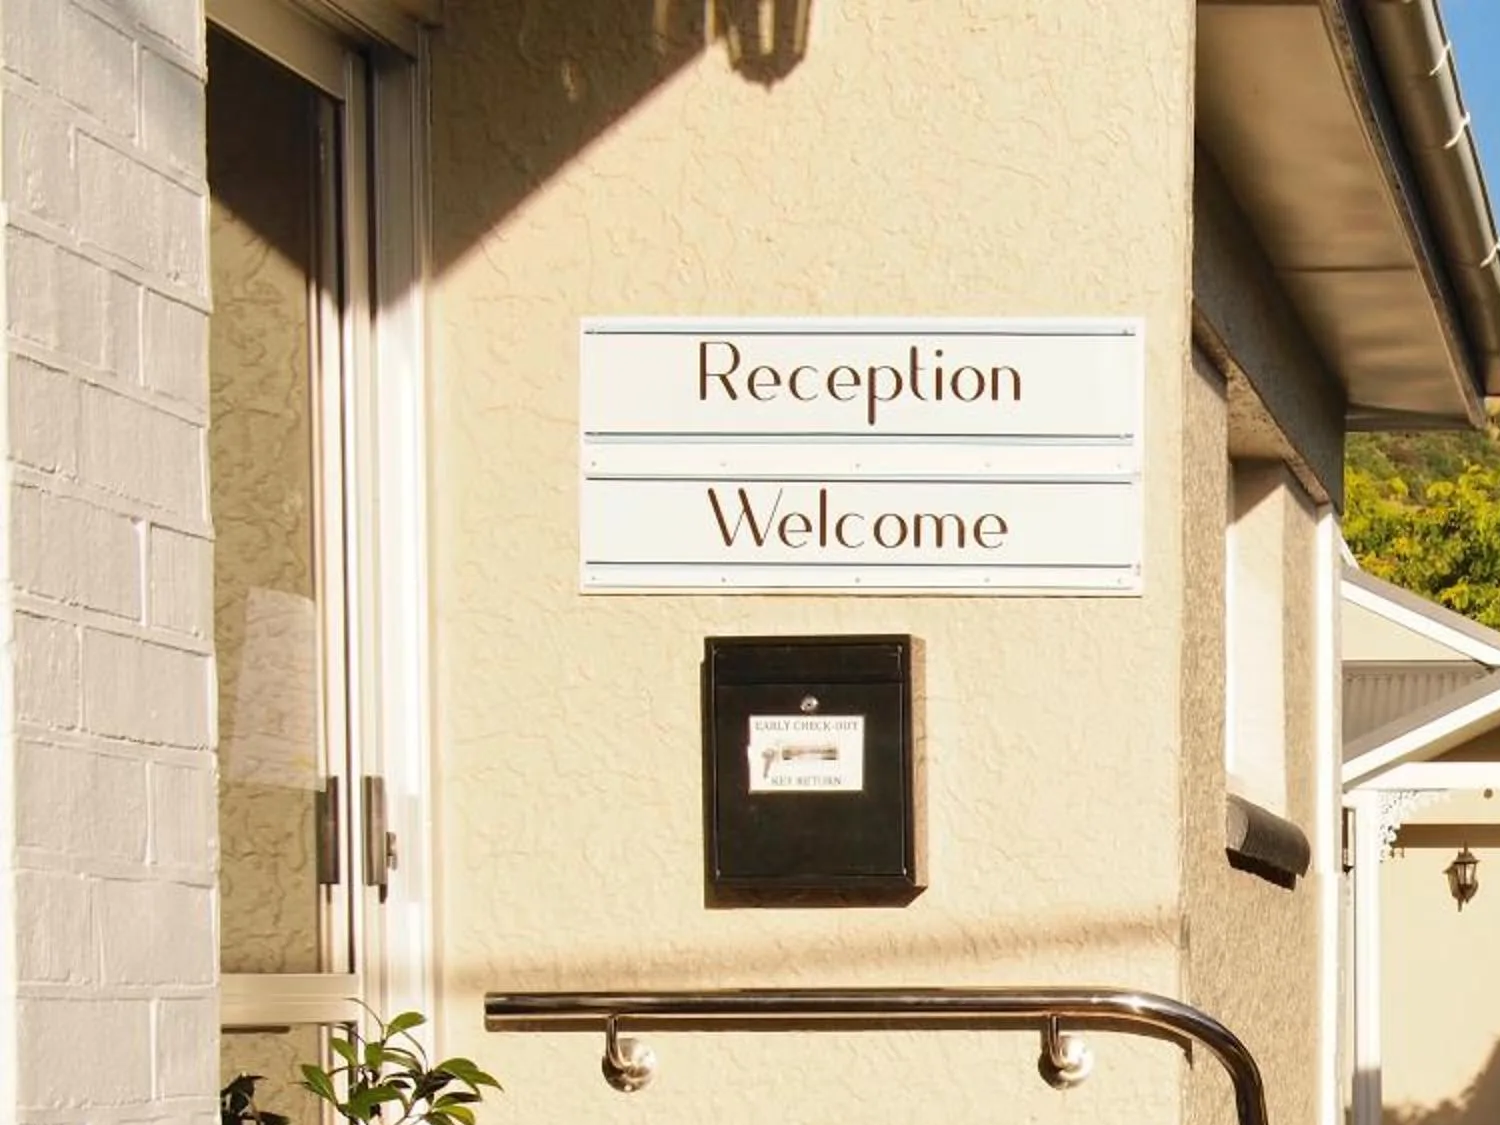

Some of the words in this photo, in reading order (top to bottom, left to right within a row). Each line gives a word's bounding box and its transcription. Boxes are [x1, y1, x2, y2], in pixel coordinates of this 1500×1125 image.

[699, 341, 1021, 425] Reception
[707, 487, 1009, 549] Welcome
[755, 720, 791, 731] EARLY
[793, 720, 858, 731] CHECK-OUT
[771, 775, 792, 785] KEY
[797, 775, 842, 785] RETURN
